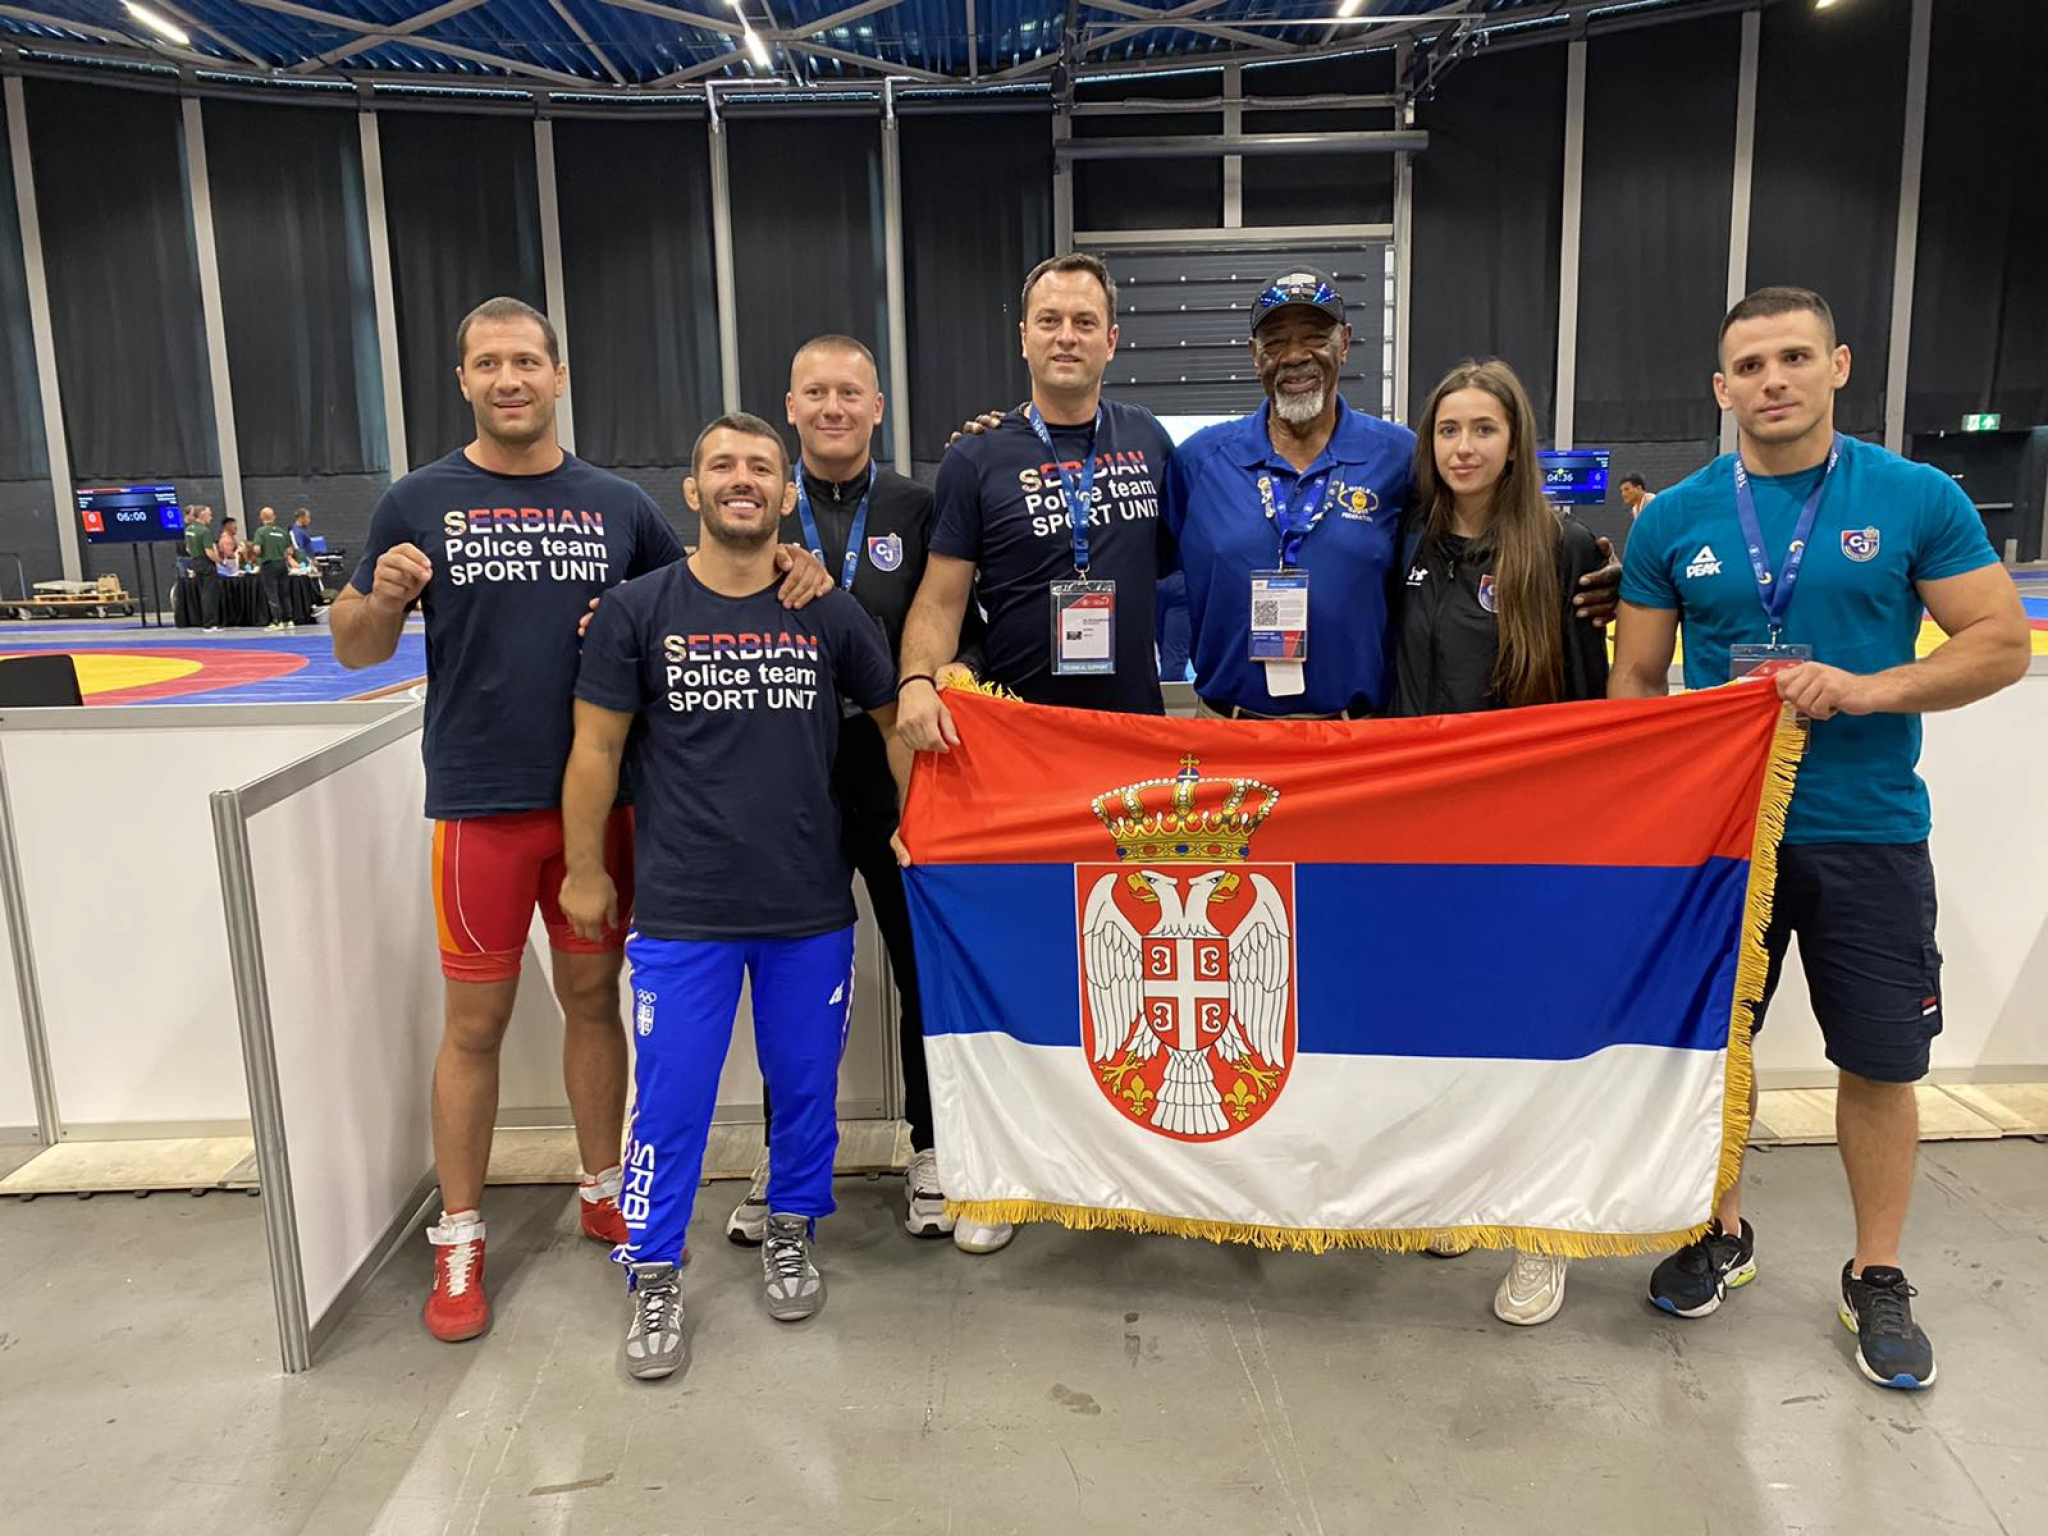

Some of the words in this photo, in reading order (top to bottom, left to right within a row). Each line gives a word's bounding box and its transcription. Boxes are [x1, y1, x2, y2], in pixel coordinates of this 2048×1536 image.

[1025, 485, 1103, 515] Pole
[1108, 478, 1158, 499] team
[443, 507, 605, 536] SERBIAN
[1032, 504, 1112, 537] SPRT
[444, 536, 533, 562] Police
[540, 536, 608, 559] team
[450, 560, 542, 586] SPORT
[551, 560, 609, 583] UNIT
[1686, 561, 1724, 579] PEAK
[663, 631, 819, 663] SERBIAN
[666, 663, 751, 688] Police
[758, 663, 817, 686] team
[667, 688, 759, 712] SPORT
